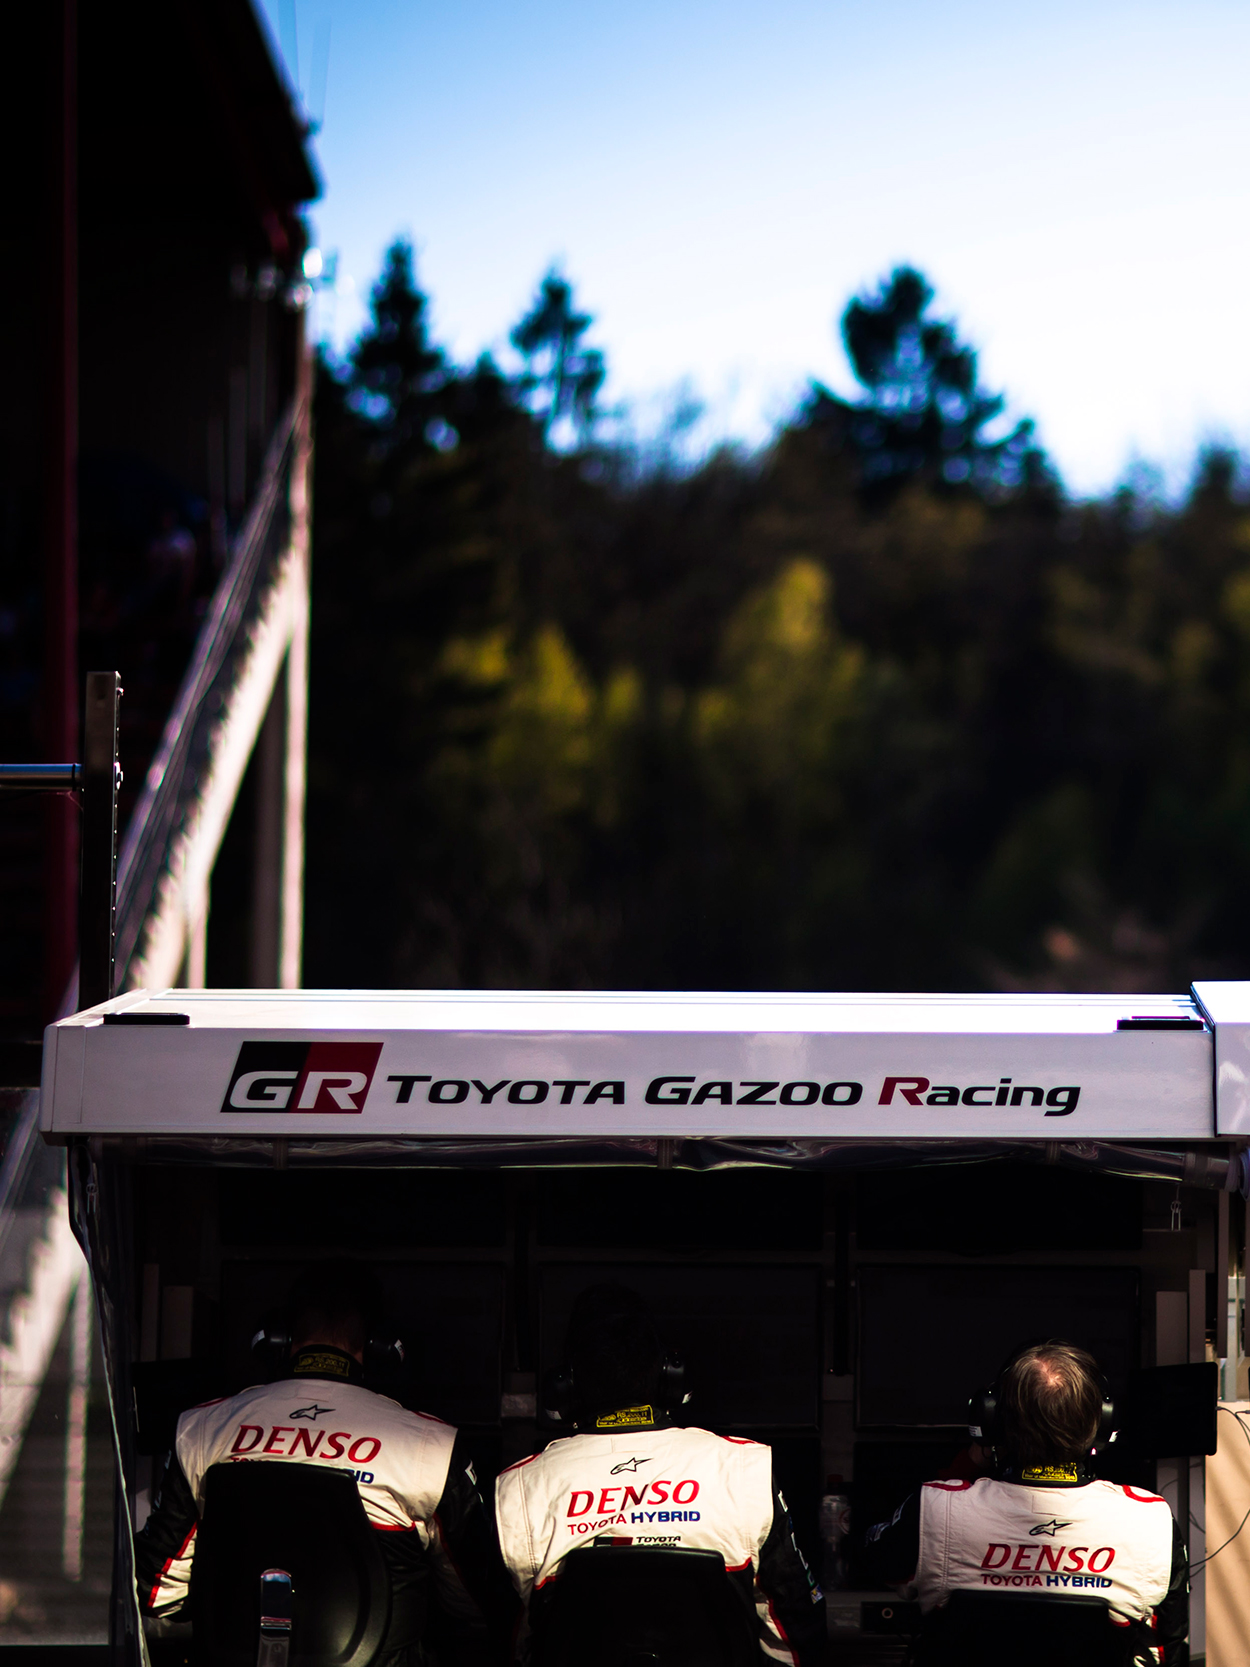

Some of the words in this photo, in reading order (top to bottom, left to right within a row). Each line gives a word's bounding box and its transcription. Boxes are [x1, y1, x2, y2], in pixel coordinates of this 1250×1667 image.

[229, 1071, 368, 1109] GR
[387, 1075, 625, 1105] TOYOTA
[644, 1076, 863, 1106] GAZOO
[878, 1077, 1081, 1116] Racing
[230, 1425, 382, 1464] DENSO
[566, 1480, 700, 1518] DENSO
[567, 1513, 627, 1536] TOYOTA
[631, 1511, 701, 1524] HYBRID
[636, 1535, 681, 1543] TOYOTA
[981, 1543, 1115, 1573] DENSO
[981, 1574, 1042, 1586] TOYOTA
[1046, 1575, 1112, 1588] HYBRID
